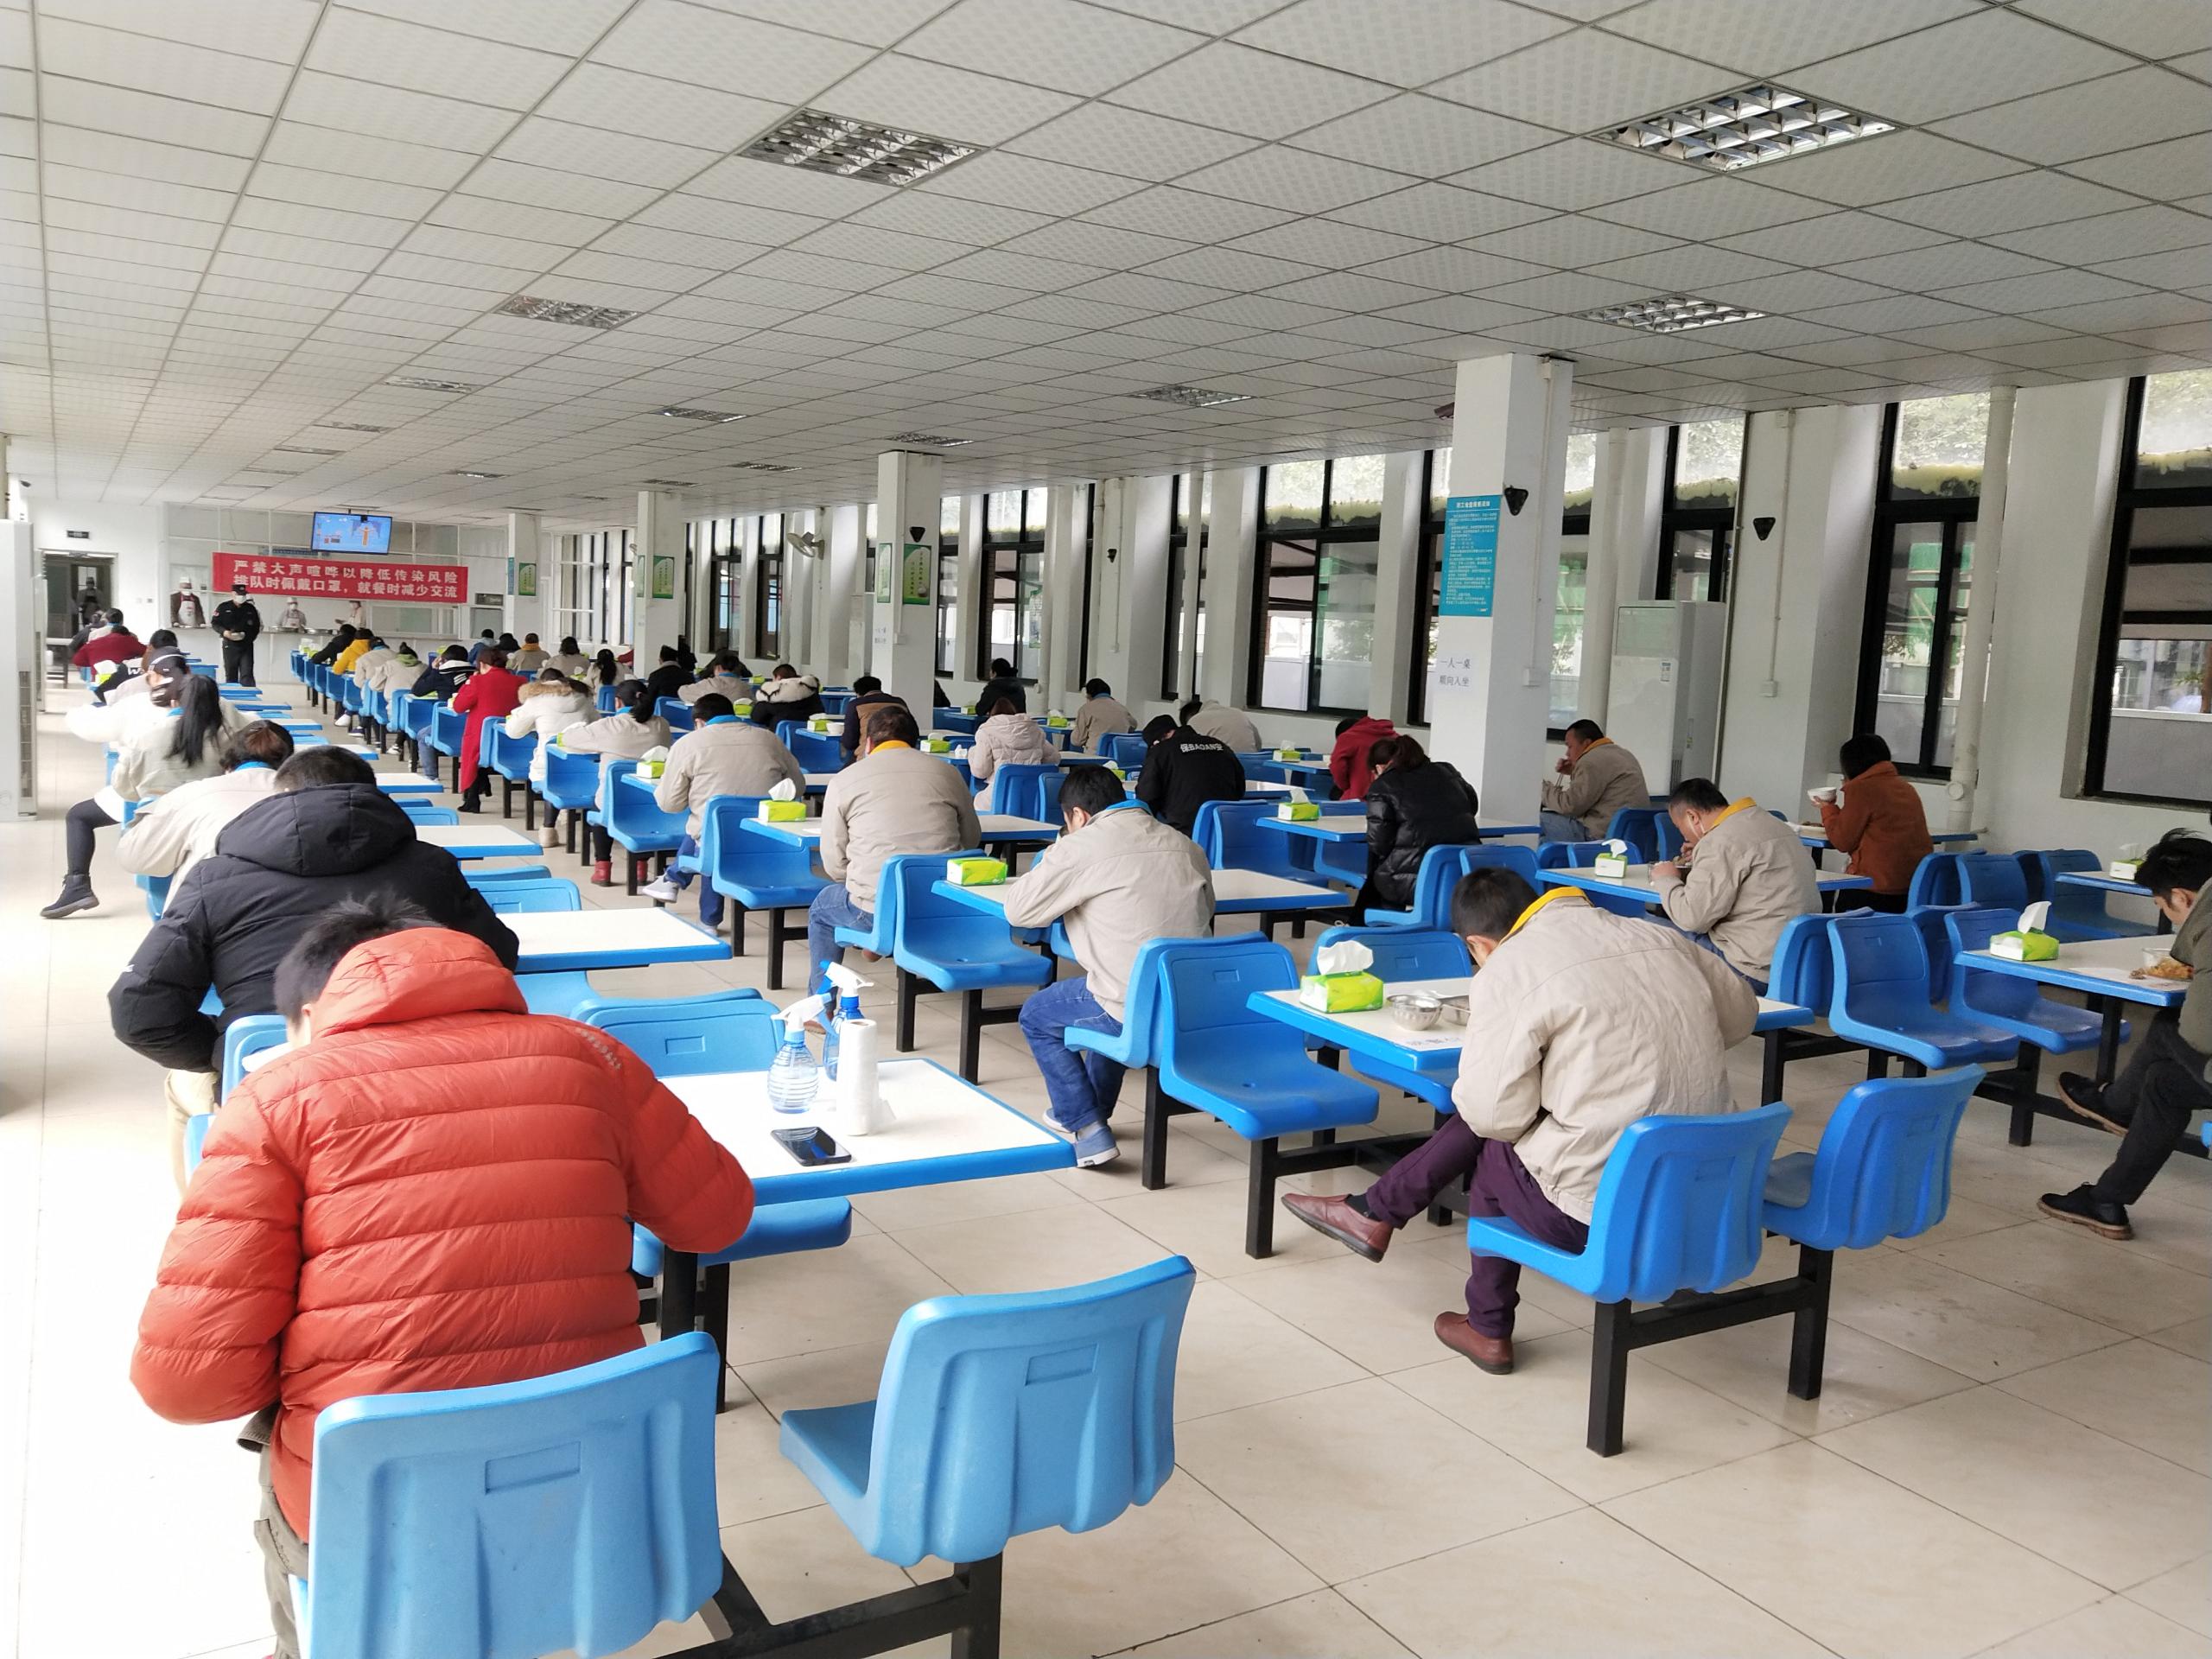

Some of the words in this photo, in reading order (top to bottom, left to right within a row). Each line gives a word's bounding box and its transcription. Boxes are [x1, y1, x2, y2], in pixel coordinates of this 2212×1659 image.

[233, 560, 458, 584] 严禁大声喧哗以降低传染风险
[1440, 658, 1471, 670] 一人一桌
